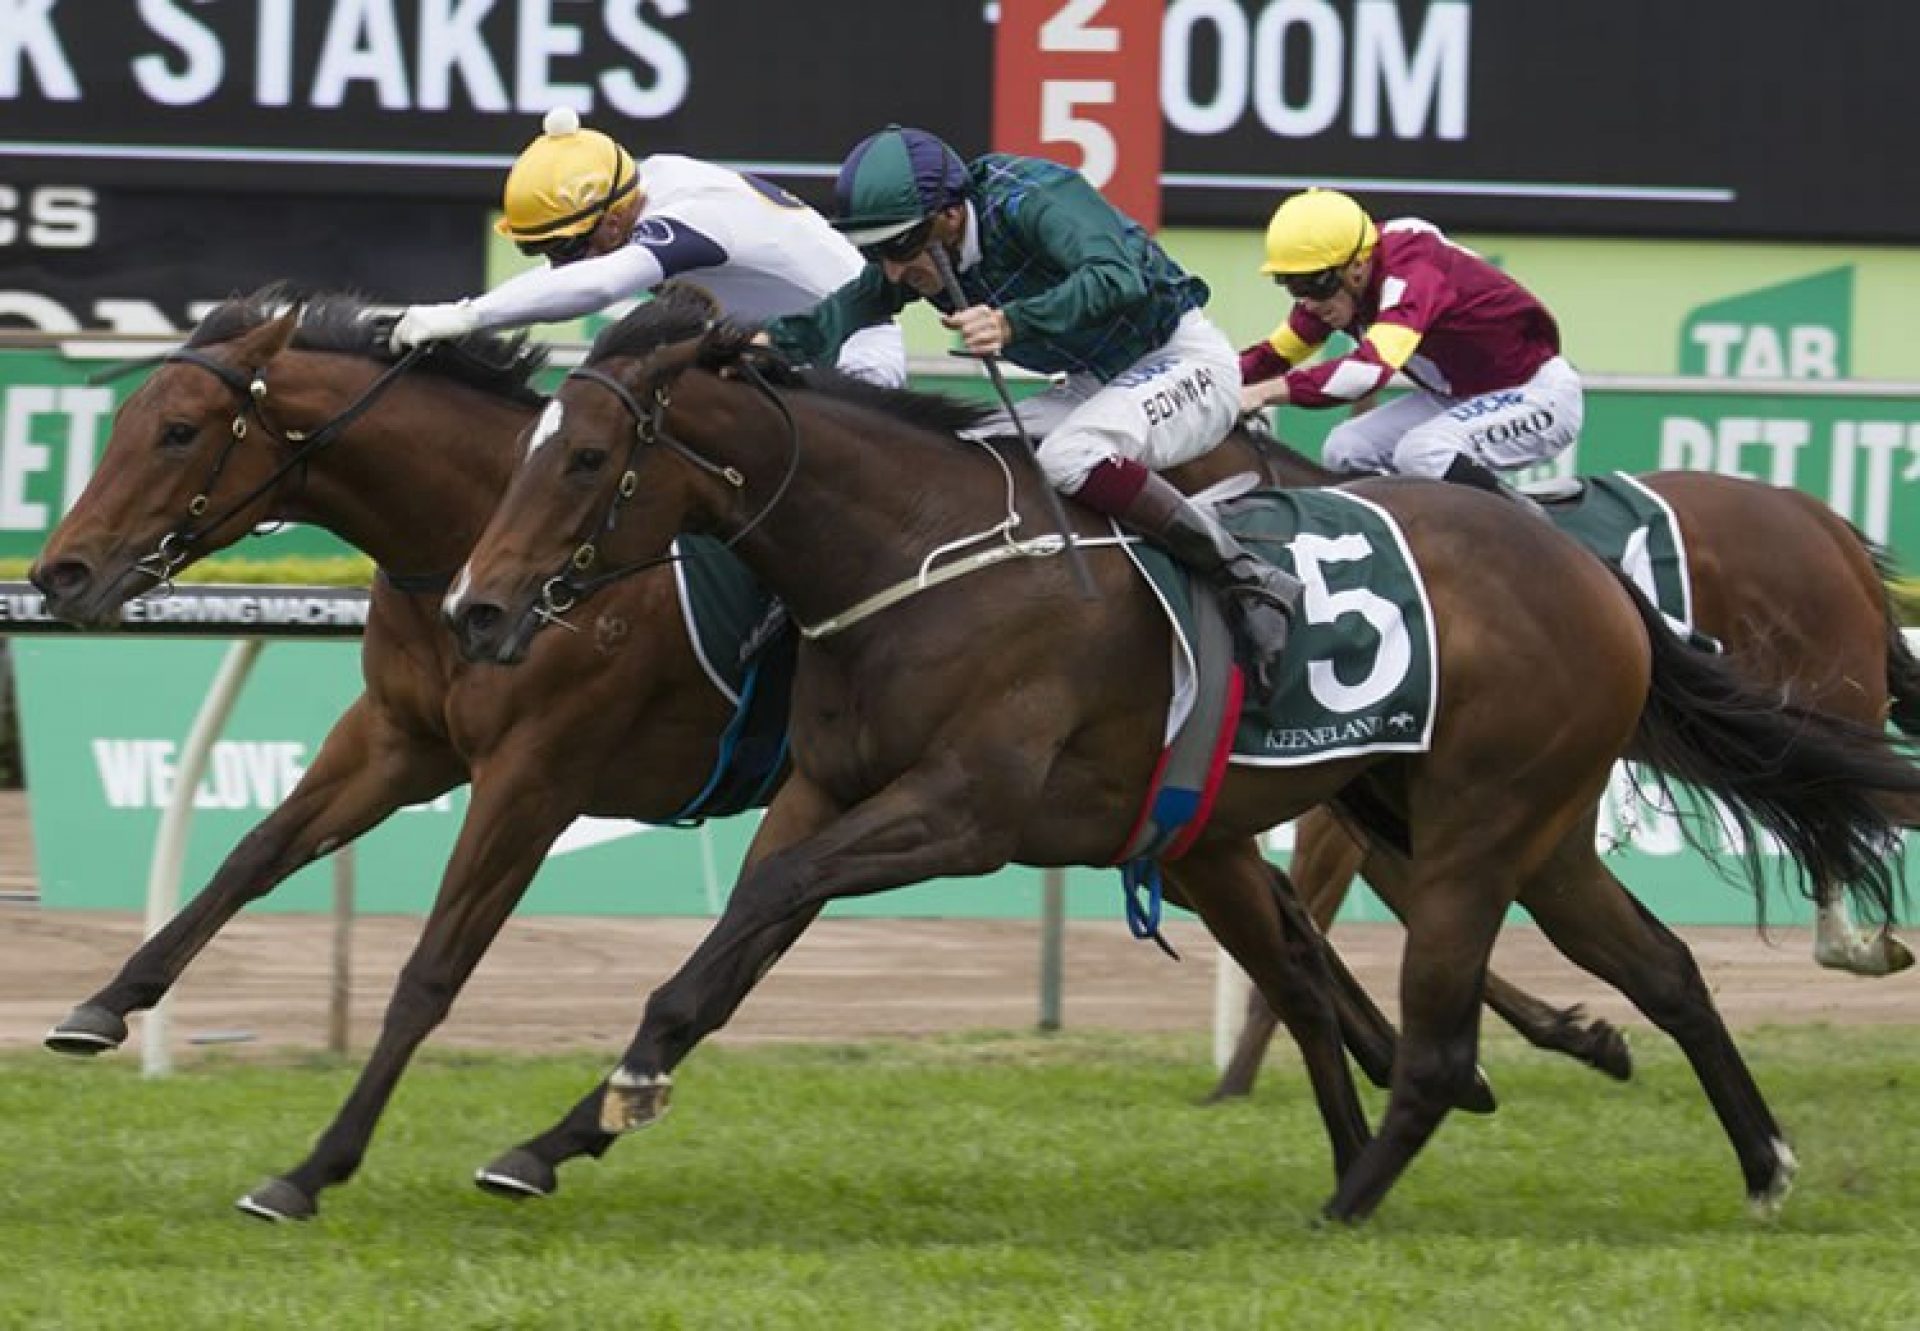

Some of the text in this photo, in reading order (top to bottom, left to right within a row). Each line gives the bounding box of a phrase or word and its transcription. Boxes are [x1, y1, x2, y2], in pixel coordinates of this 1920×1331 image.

[132, 0, 690, 119] STAKES
[1040, 80, 1118, 190] 5
[1692, 322, 1838, 379] TAB
[1285, 531, 1412, 713] 5
[1264, 715, 1384, 750] KEENELAND
